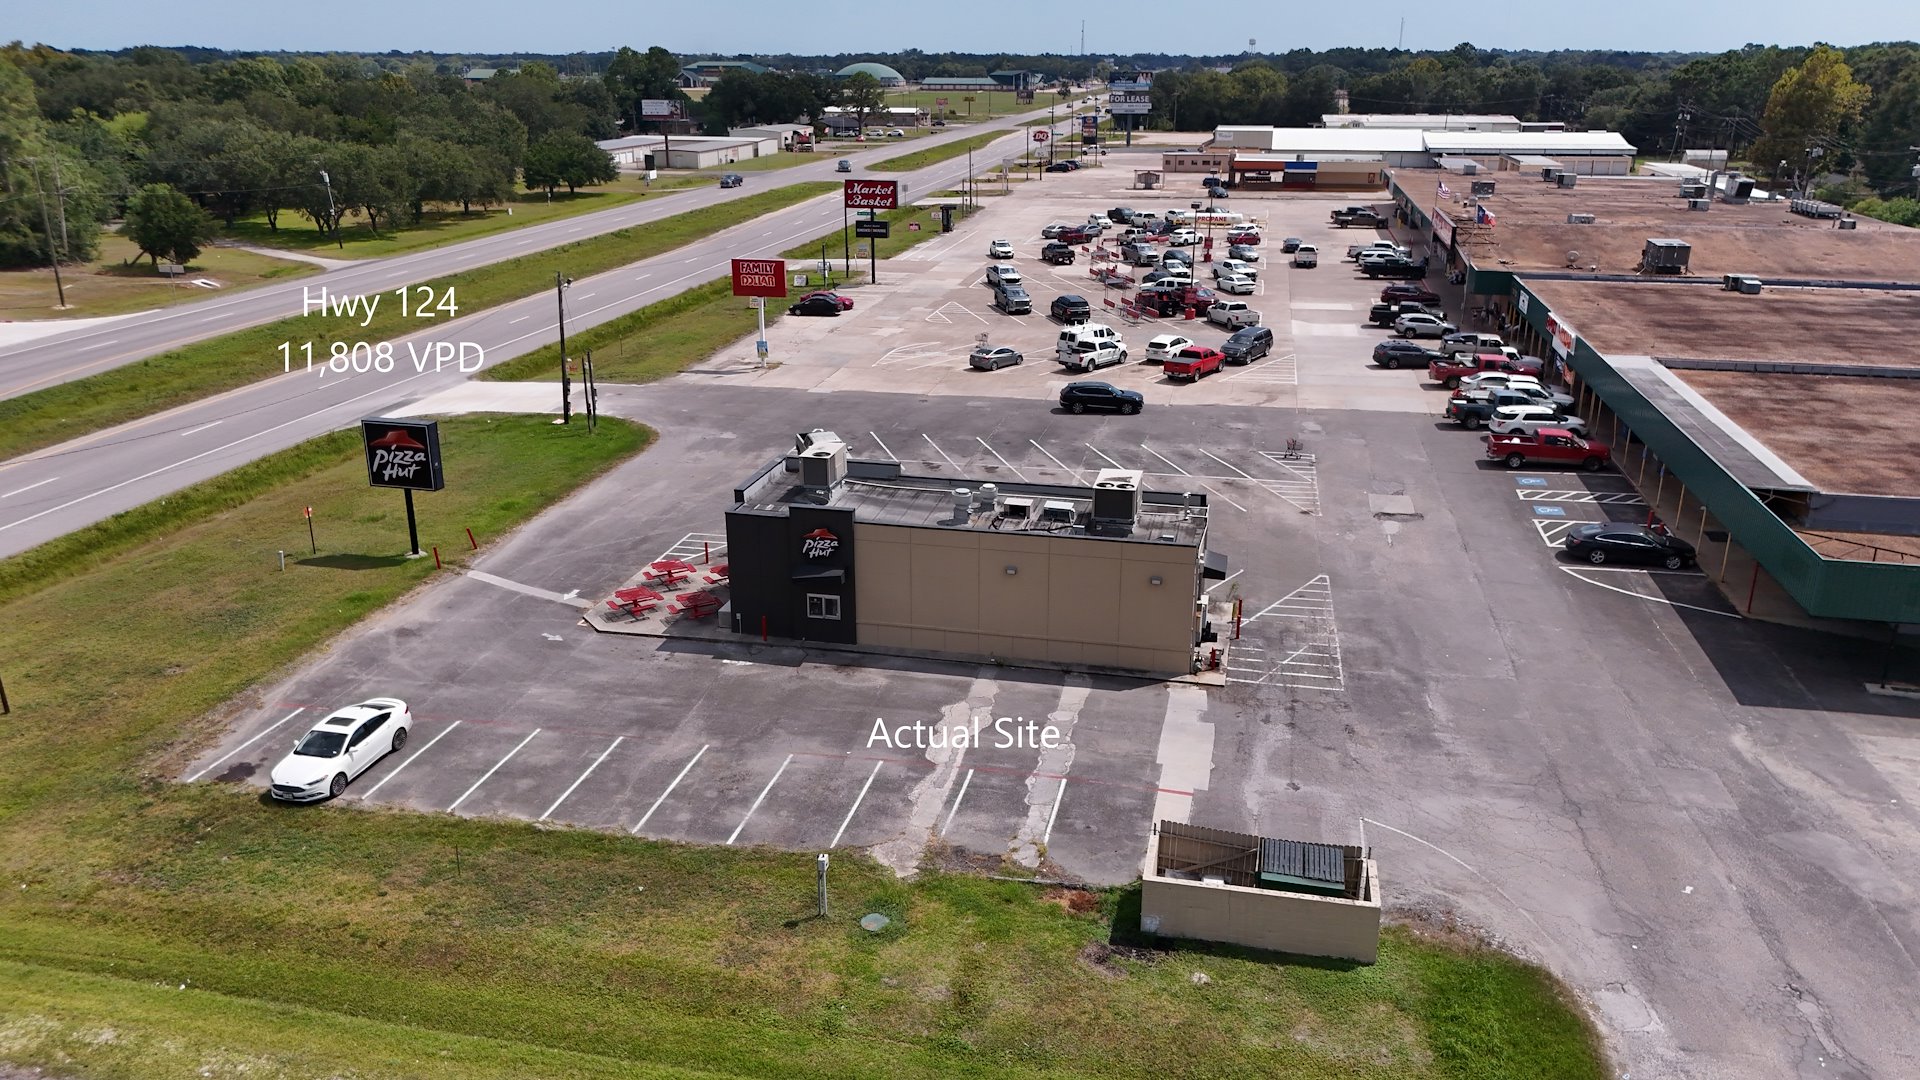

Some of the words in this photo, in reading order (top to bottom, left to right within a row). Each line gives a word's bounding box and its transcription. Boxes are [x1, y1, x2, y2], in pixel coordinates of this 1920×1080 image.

[848, 182, 894, 195] Market
[848, 195, 893, 207] Basket
[740, 262, 775, 274] FAMILY
[741, 275, 776, 287] DOLLAR
[382, 463, 422, 482] Hut
[809, 548, 835, 559] Hut
